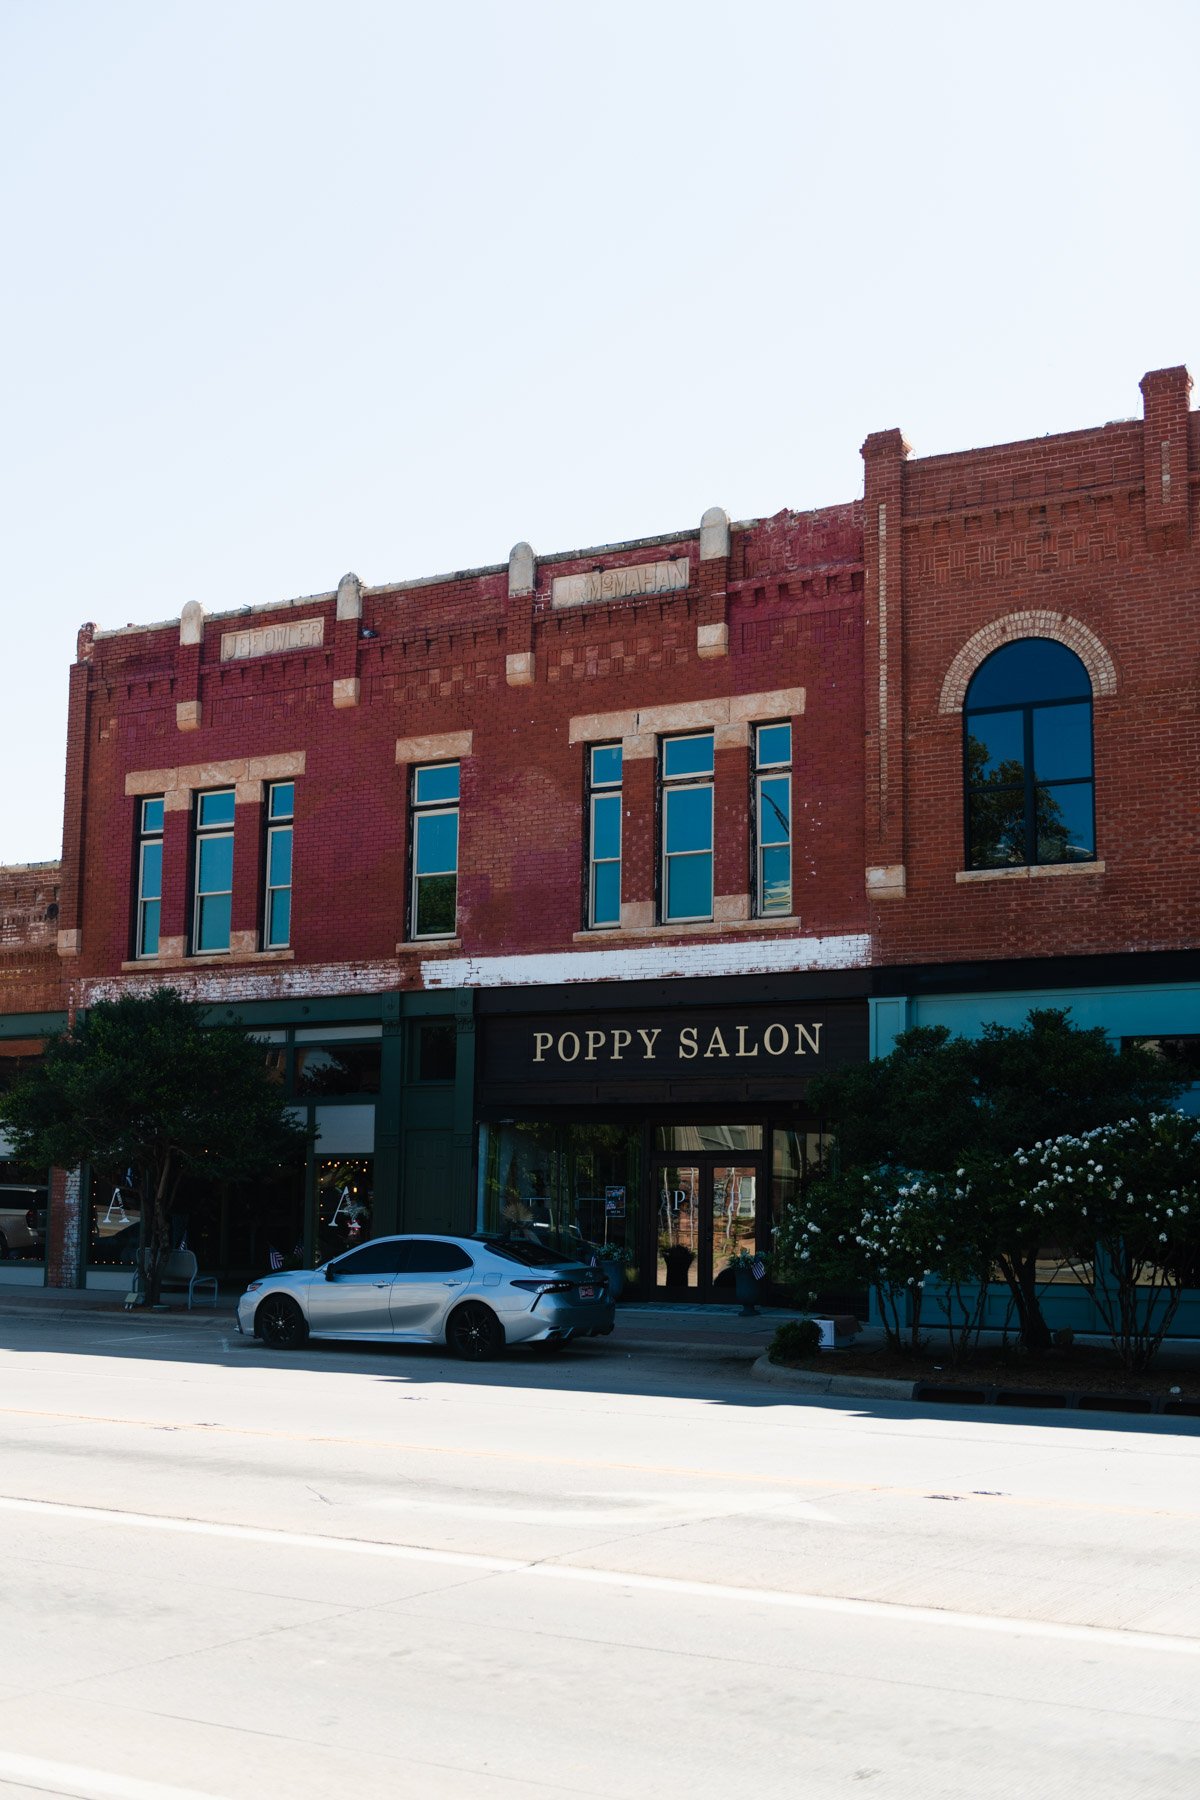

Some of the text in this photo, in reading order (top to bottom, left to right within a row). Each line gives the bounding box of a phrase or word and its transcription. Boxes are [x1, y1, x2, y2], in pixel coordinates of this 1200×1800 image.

[532, 1023, 823, 1062] POPPY SALON
[673, 1190, 686, 1211] P
